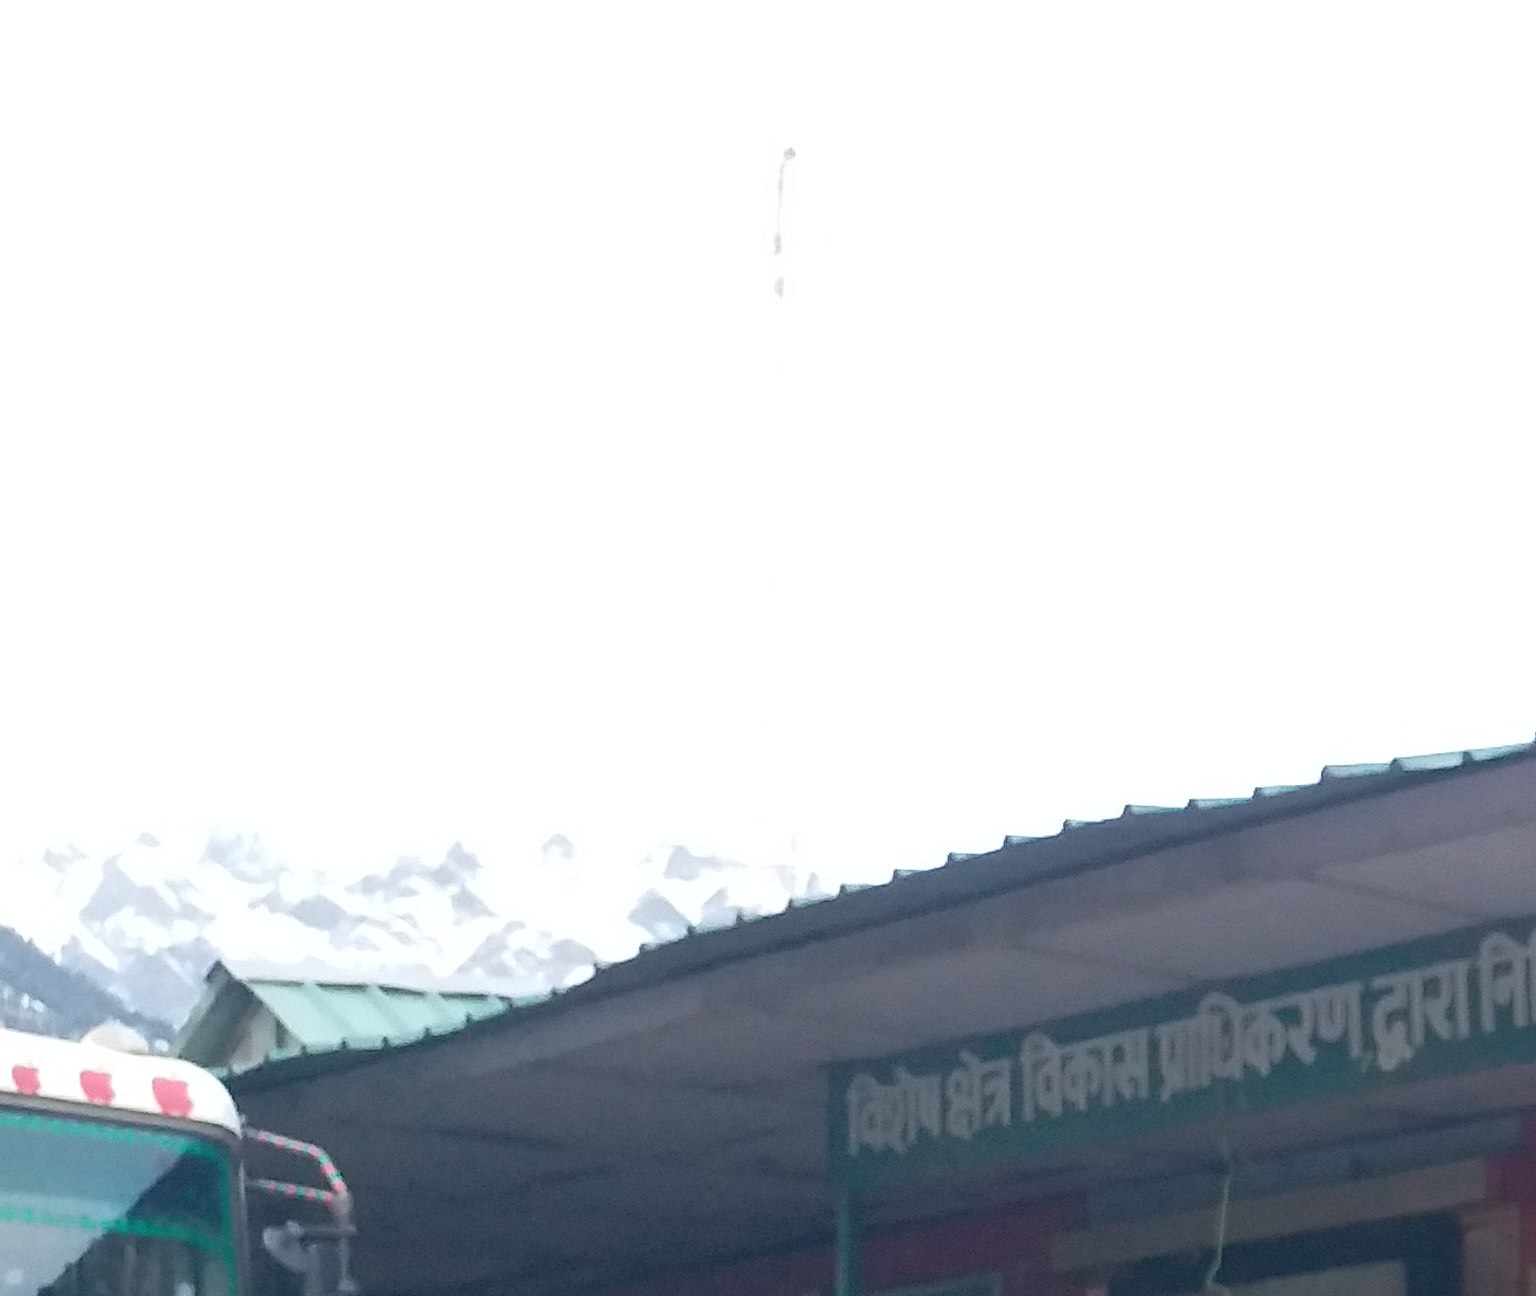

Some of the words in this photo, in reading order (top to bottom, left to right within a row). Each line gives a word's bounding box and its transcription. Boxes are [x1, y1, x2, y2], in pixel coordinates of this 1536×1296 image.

[847, 1066, 941, 1156] विशेष
[945, 1049, 1012, 1139] क्षेत्र
[1019, 1031, 1149, 1123] विकास
[1156, 982, 1362, 1102] प्राधिकरण
[1371, 957, 1472, 1071] द्वारा
